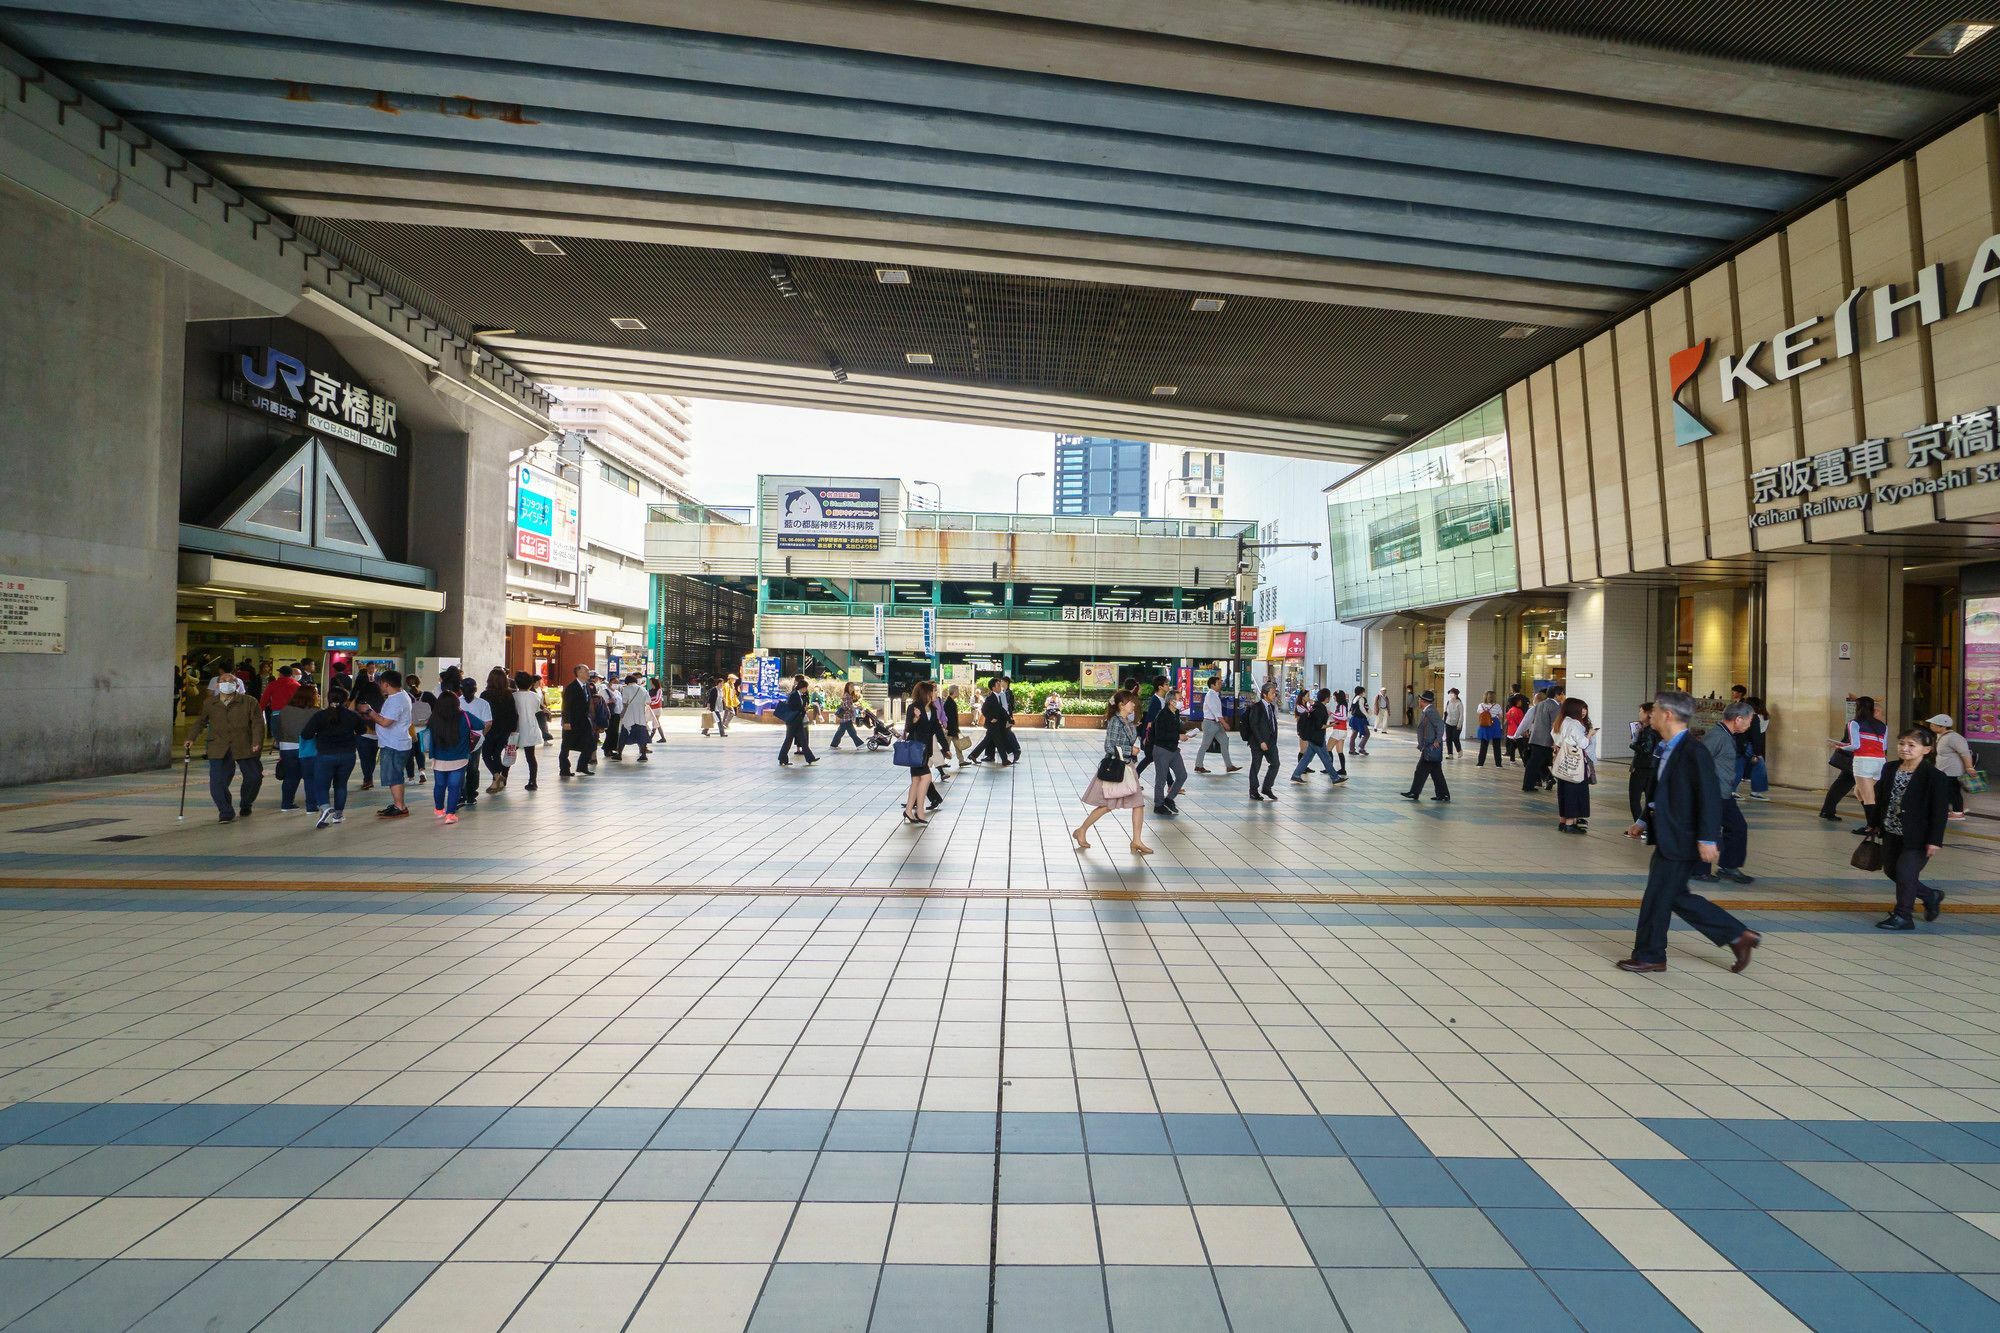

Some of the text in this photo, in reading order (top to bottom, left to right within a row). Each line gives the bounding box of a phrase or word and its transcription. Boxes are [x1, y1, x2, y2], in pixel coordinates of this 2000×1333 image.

[242, 346, 306, 403] JR
[252, 395, 297, 420] JR西日本
[309, 369, 397, 440] 京橋駅
[309, 415, 396, 456] KYOBASHI STATION
[1750, 405, 2000, 504] 京阪電車 京橋
[1748, 462, 2000, 528] Keihan Railway Kyobashi St
[784, 519, 874, 530] 藍の都脳神経外科病院
[1548, 630, 1567, 640] EA
